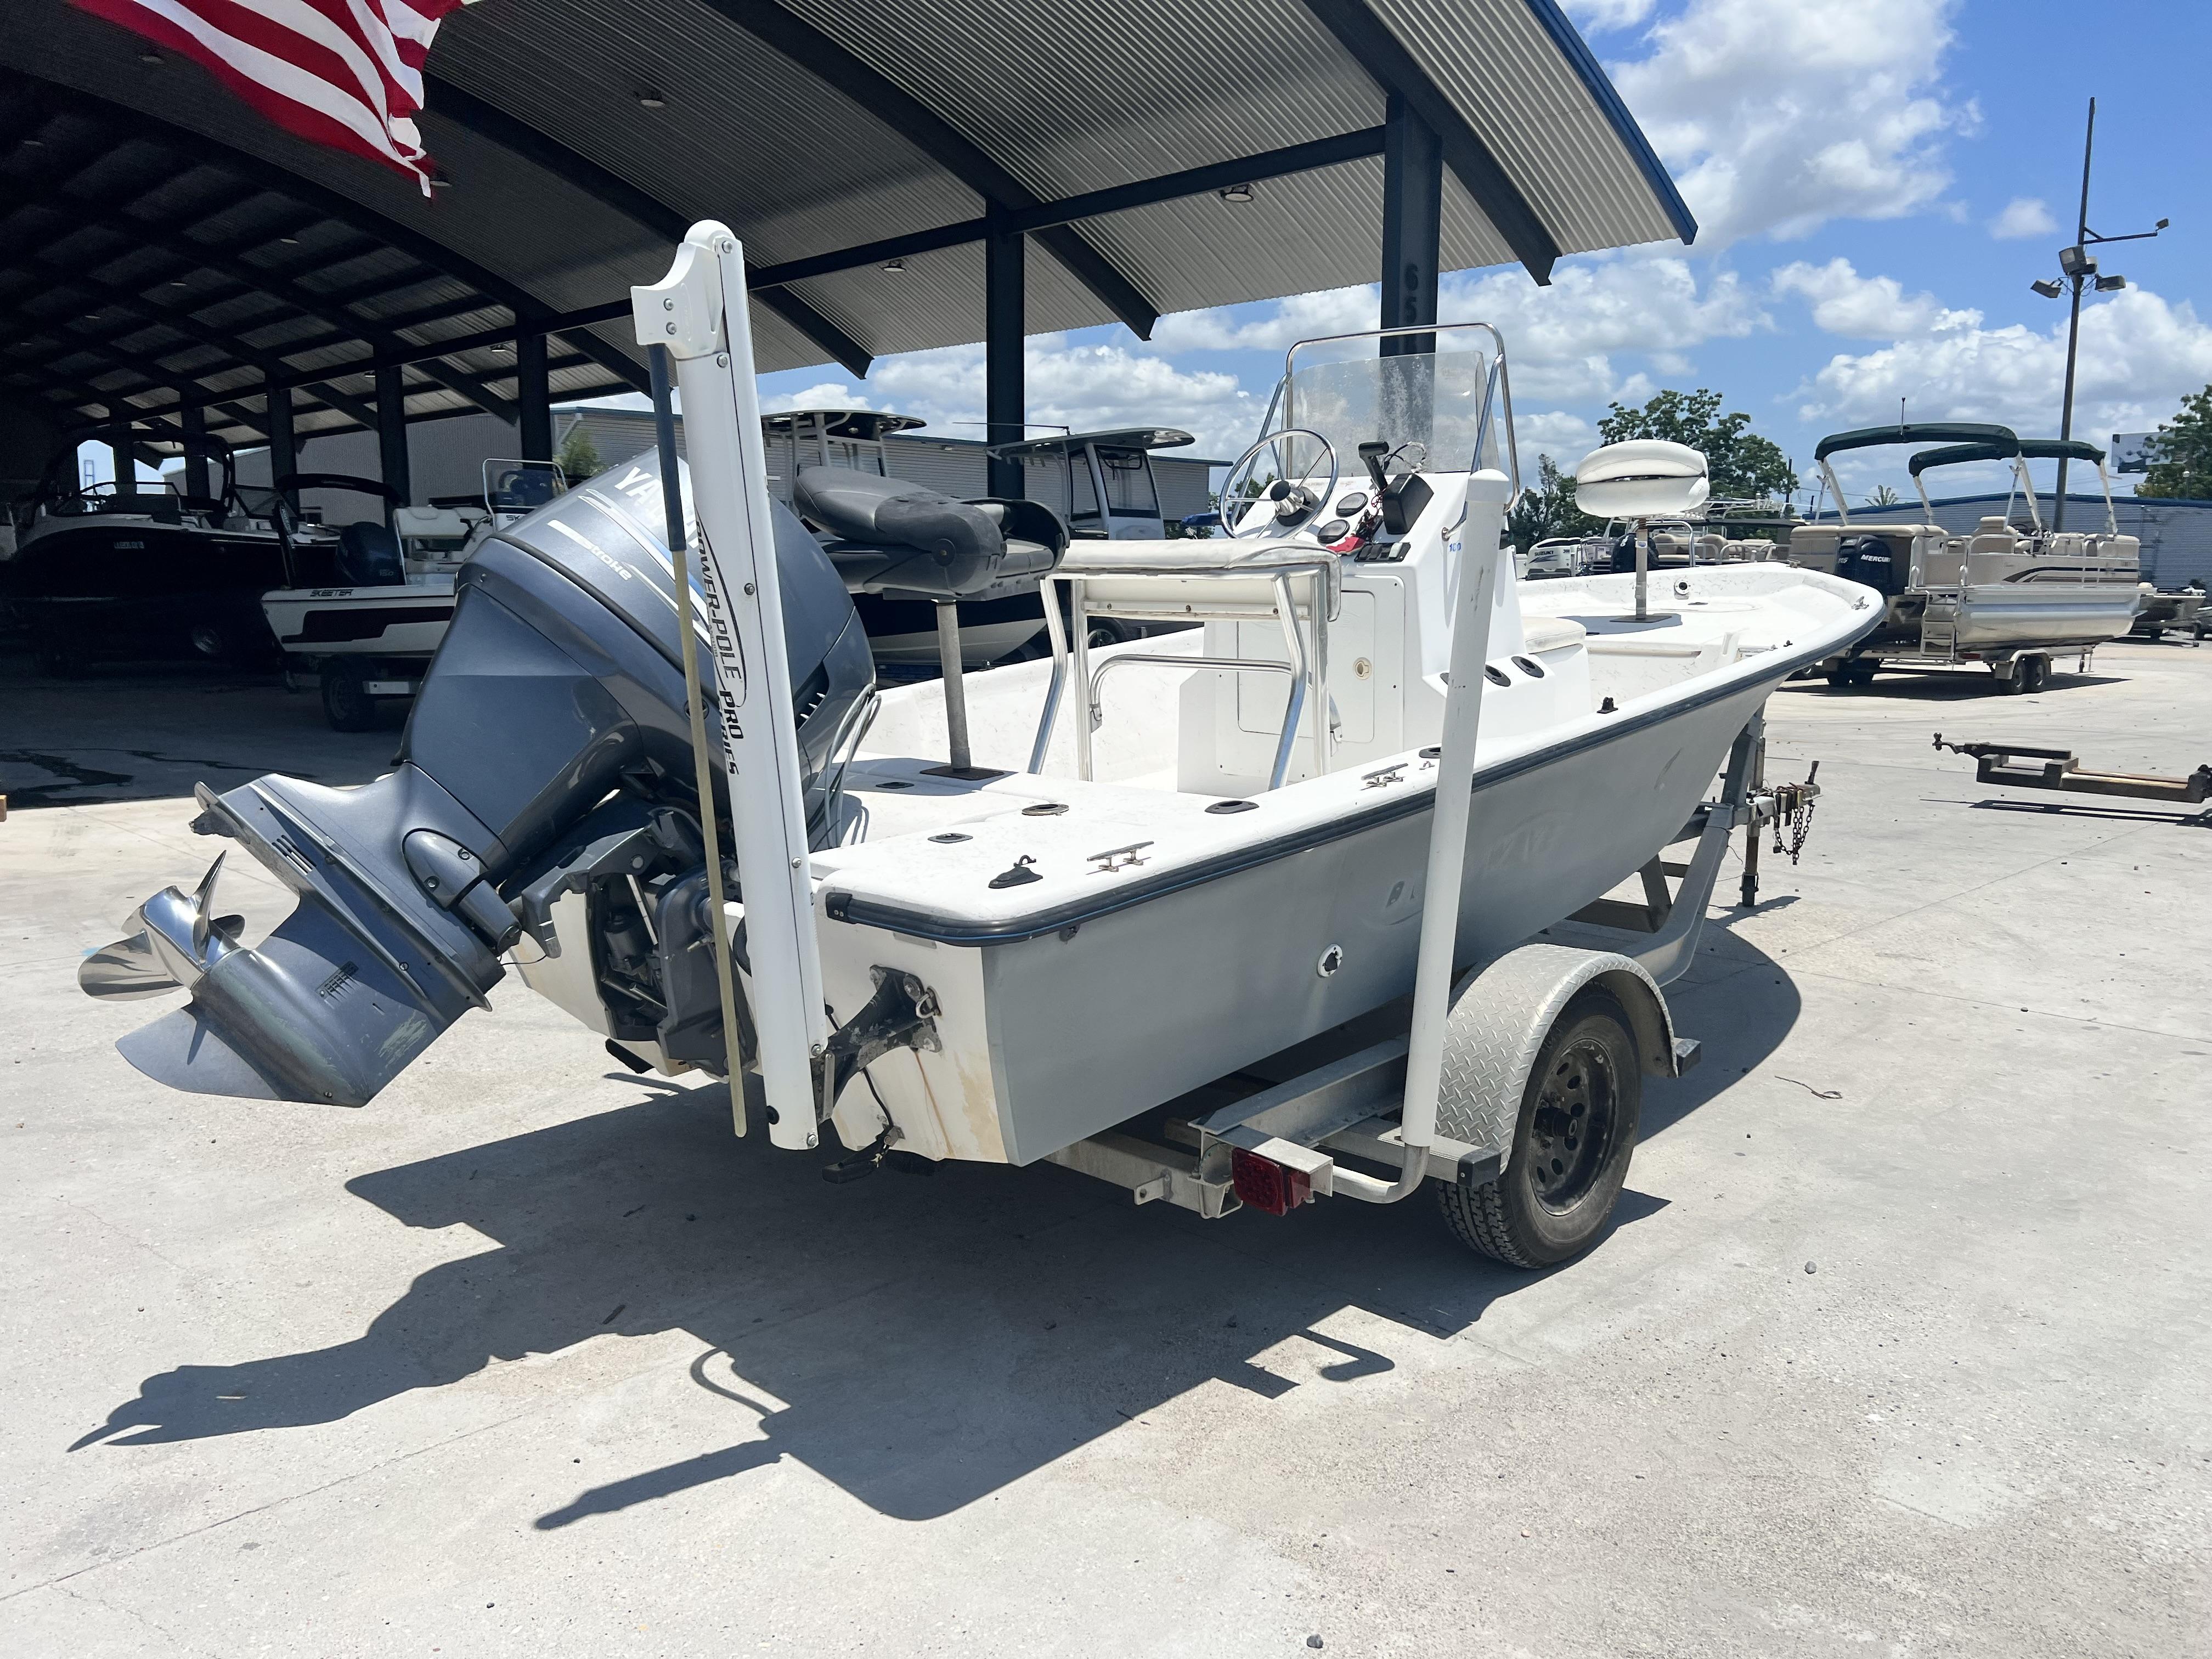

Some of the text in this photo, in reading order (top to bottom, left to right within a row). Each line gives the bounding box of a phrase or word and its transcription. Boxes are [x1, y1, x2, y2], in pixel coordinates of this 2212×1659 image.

[309, 589, 354, 597] SKEETER
[718, 700, 740, 775] RIES
[719, 690, 744, 739] PRO
